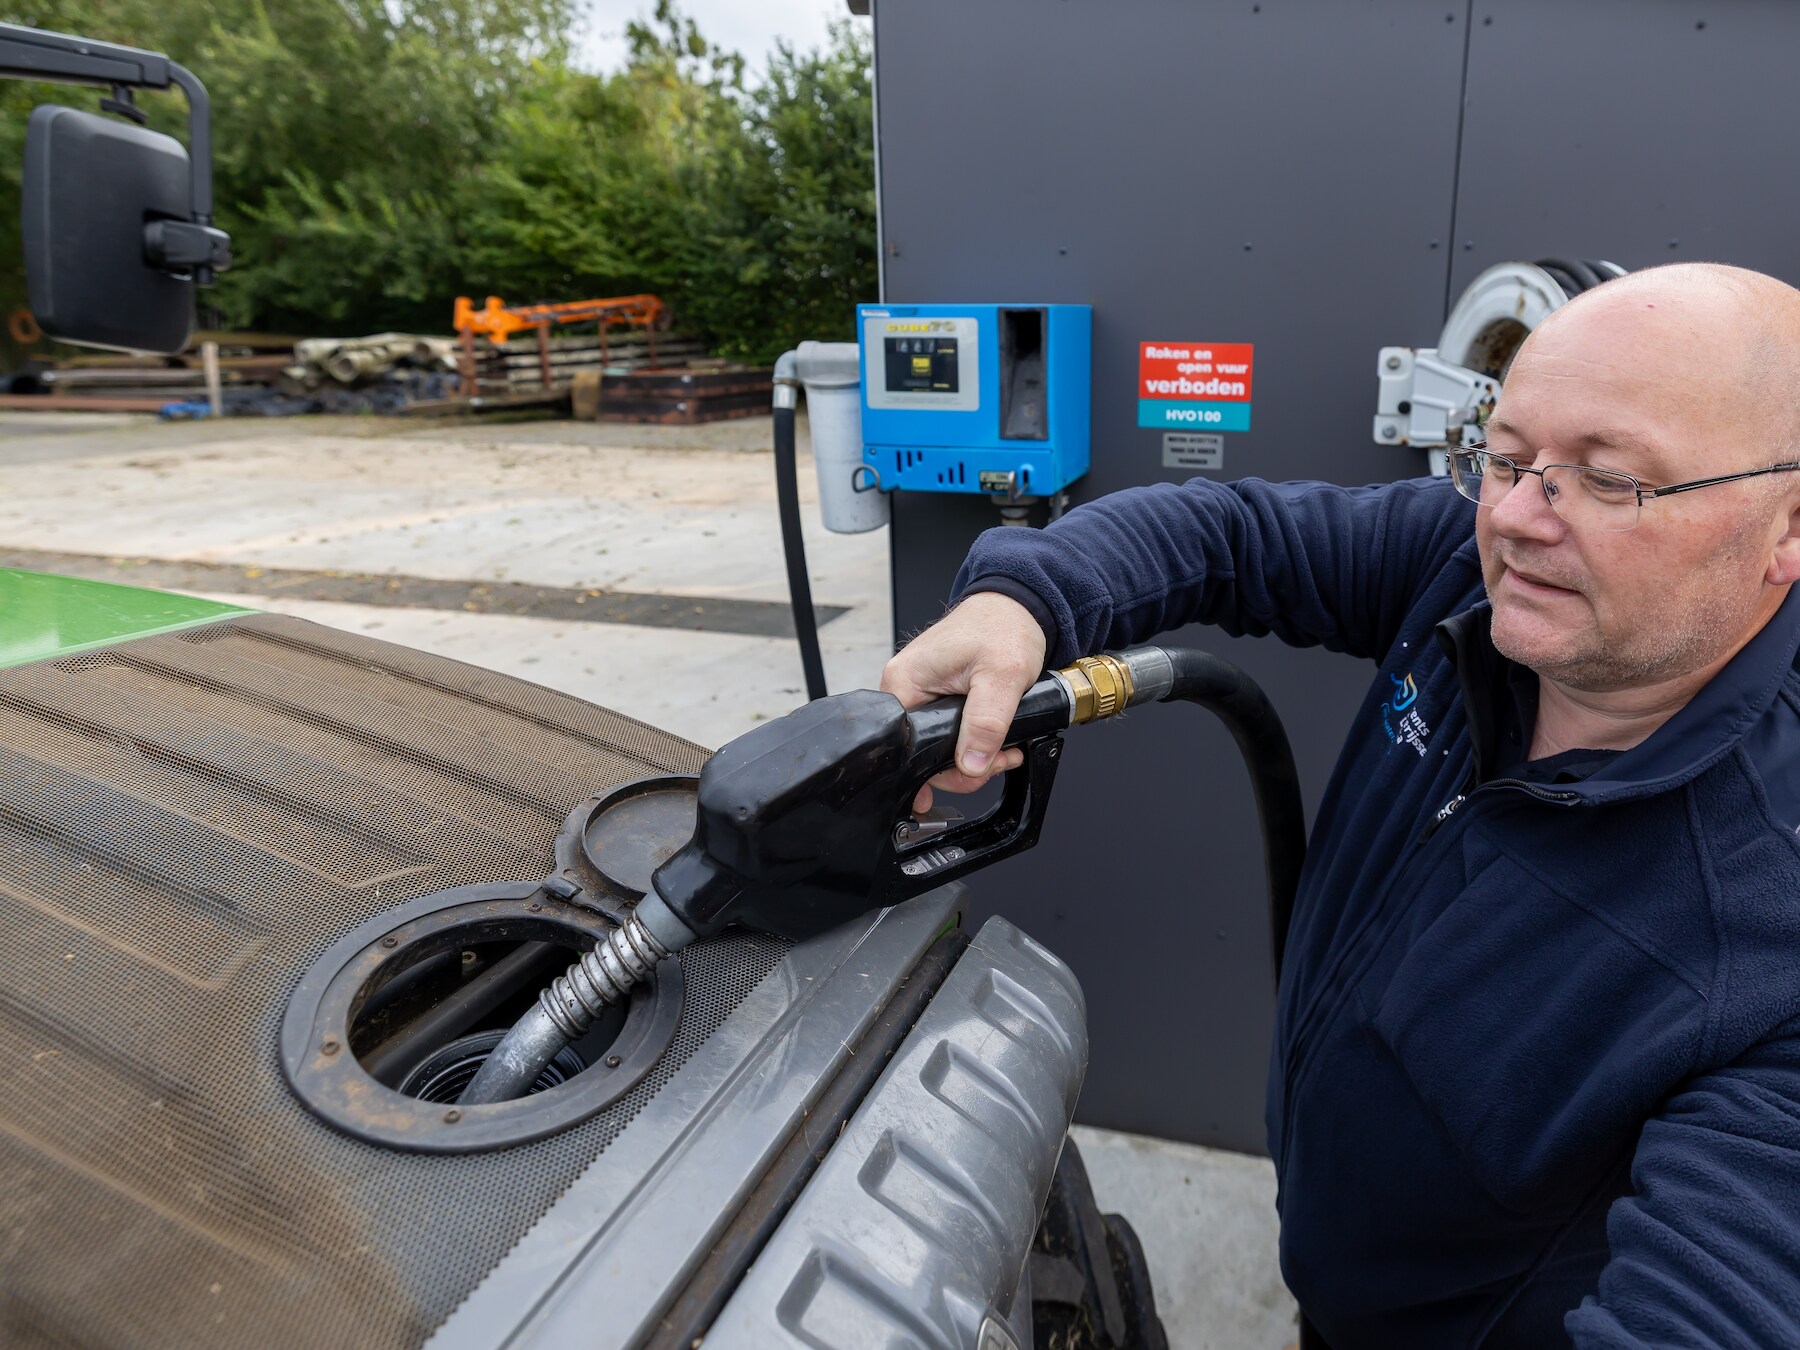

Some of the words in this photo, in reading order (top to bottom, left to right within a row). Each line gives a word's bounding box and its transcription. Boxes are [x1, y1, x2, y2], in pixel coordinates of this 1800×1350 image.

[1145, 346, 1190, 360] Roken
[1193, 350, 1213, 360] en
[1176, 362, 1213, 375] open
[1216, 364, 1249, 374] vuur
[1145, 377, 1245, 396] verboden
[1165, 409, 1222, 422] HVO100
